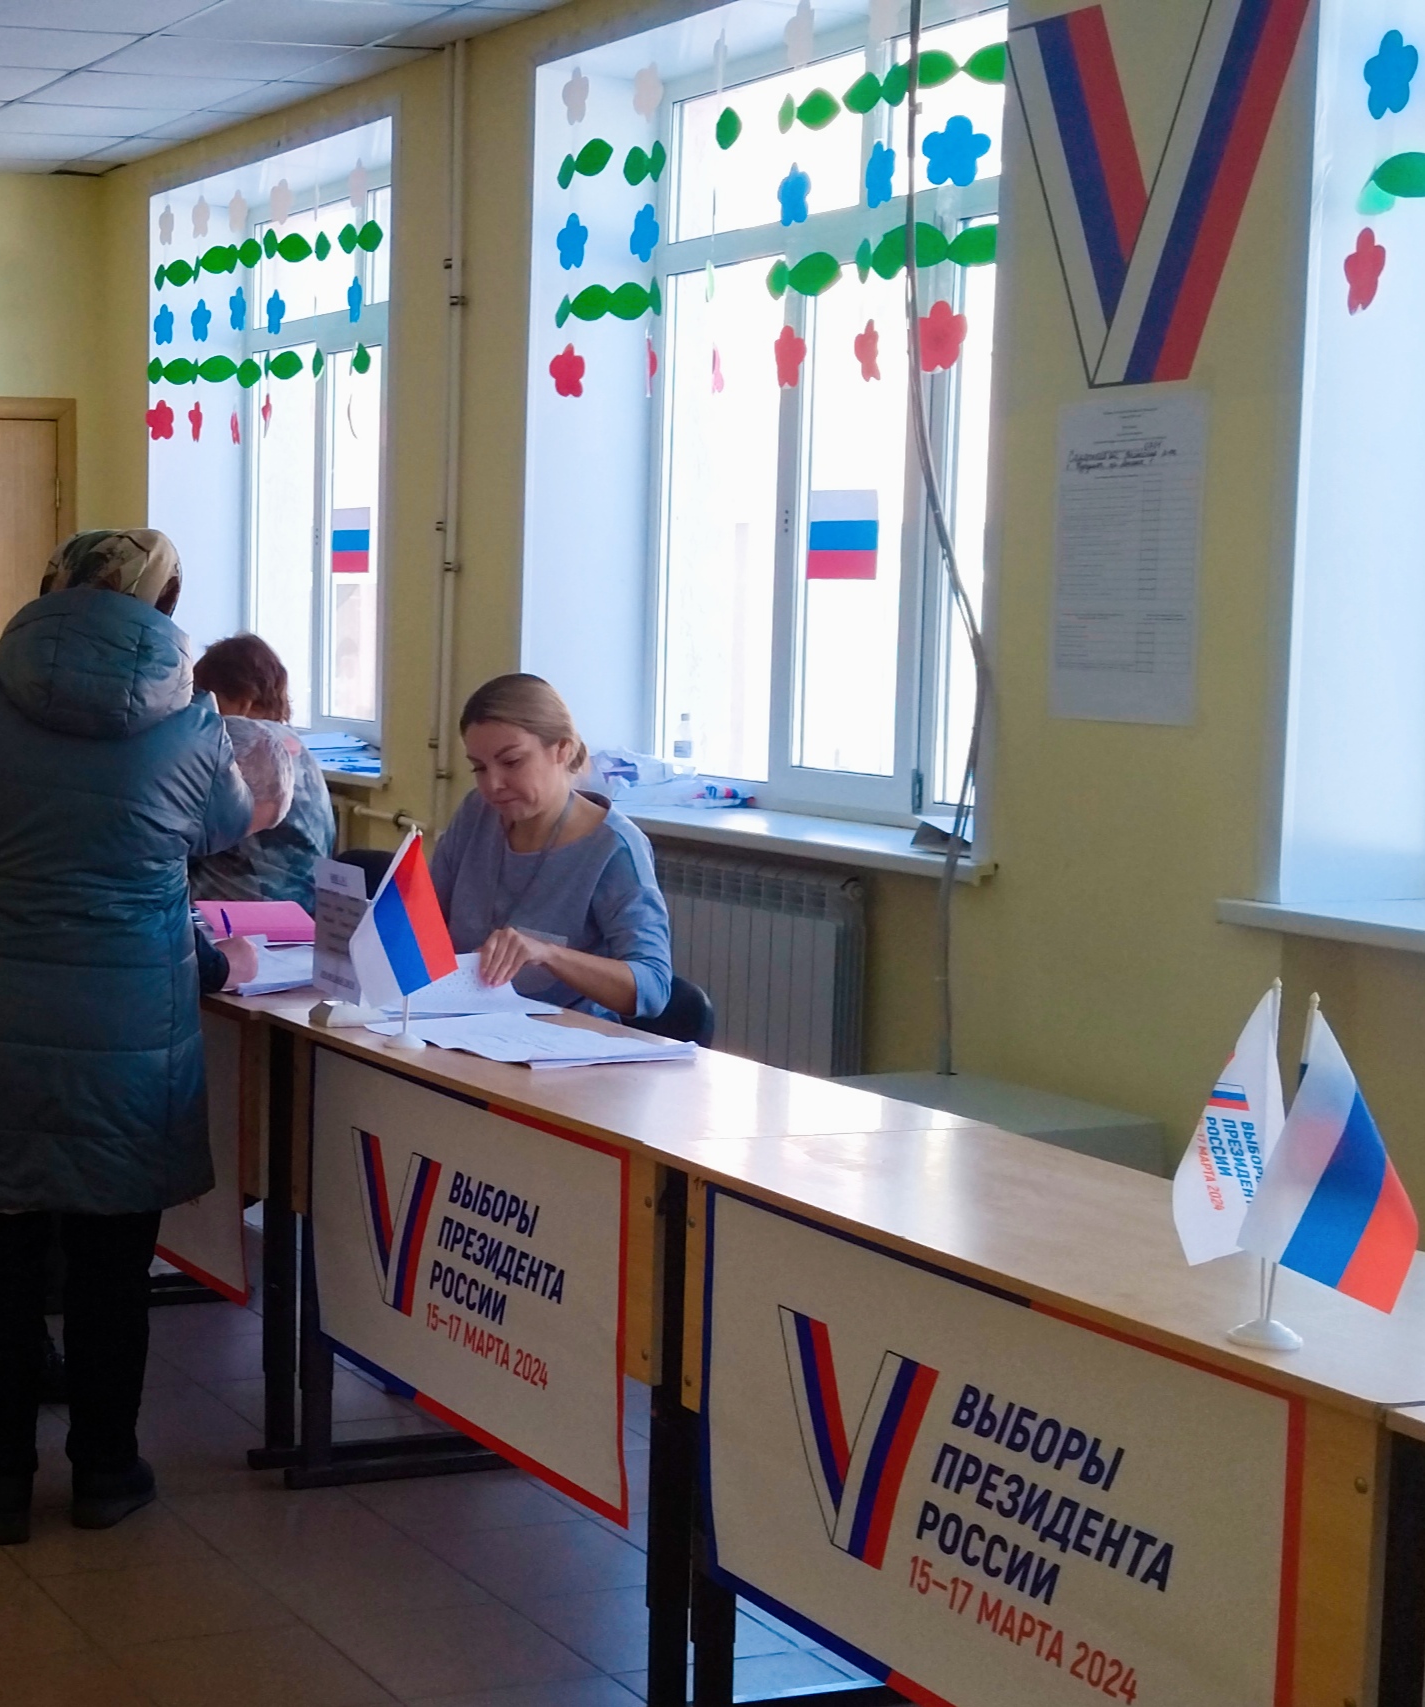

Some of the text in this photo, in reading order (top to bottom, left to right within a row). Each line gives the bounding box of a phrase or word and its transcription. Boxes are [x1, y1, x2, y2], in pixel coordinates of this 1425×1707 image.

[1197, 1146, 1216, 1182] МАРТА
[1207, 1185, 1225, 1210] 2024
[1206, 1116, 1233, 1176] РОССИИ
[448, 1171, 540, 1238] ВЫБОРЫ
[429, 1260, 507, 1325] РОССИИ
[437, 1216, 565, 1304] ПРЕЗИДЕНТА
[427, 1303, 548, 1390] 15–17 МАРТА 2024
[951, 1383, 1125, 1492] ВЫБОРЫ
[916, 1500, 1061, 1605] РОССИИ
[931, 1443, 1174, 1592] ПРЕЗИДЕНТА
[909, 1555, 1137, 1705] 15–17 МАРТА 2024
